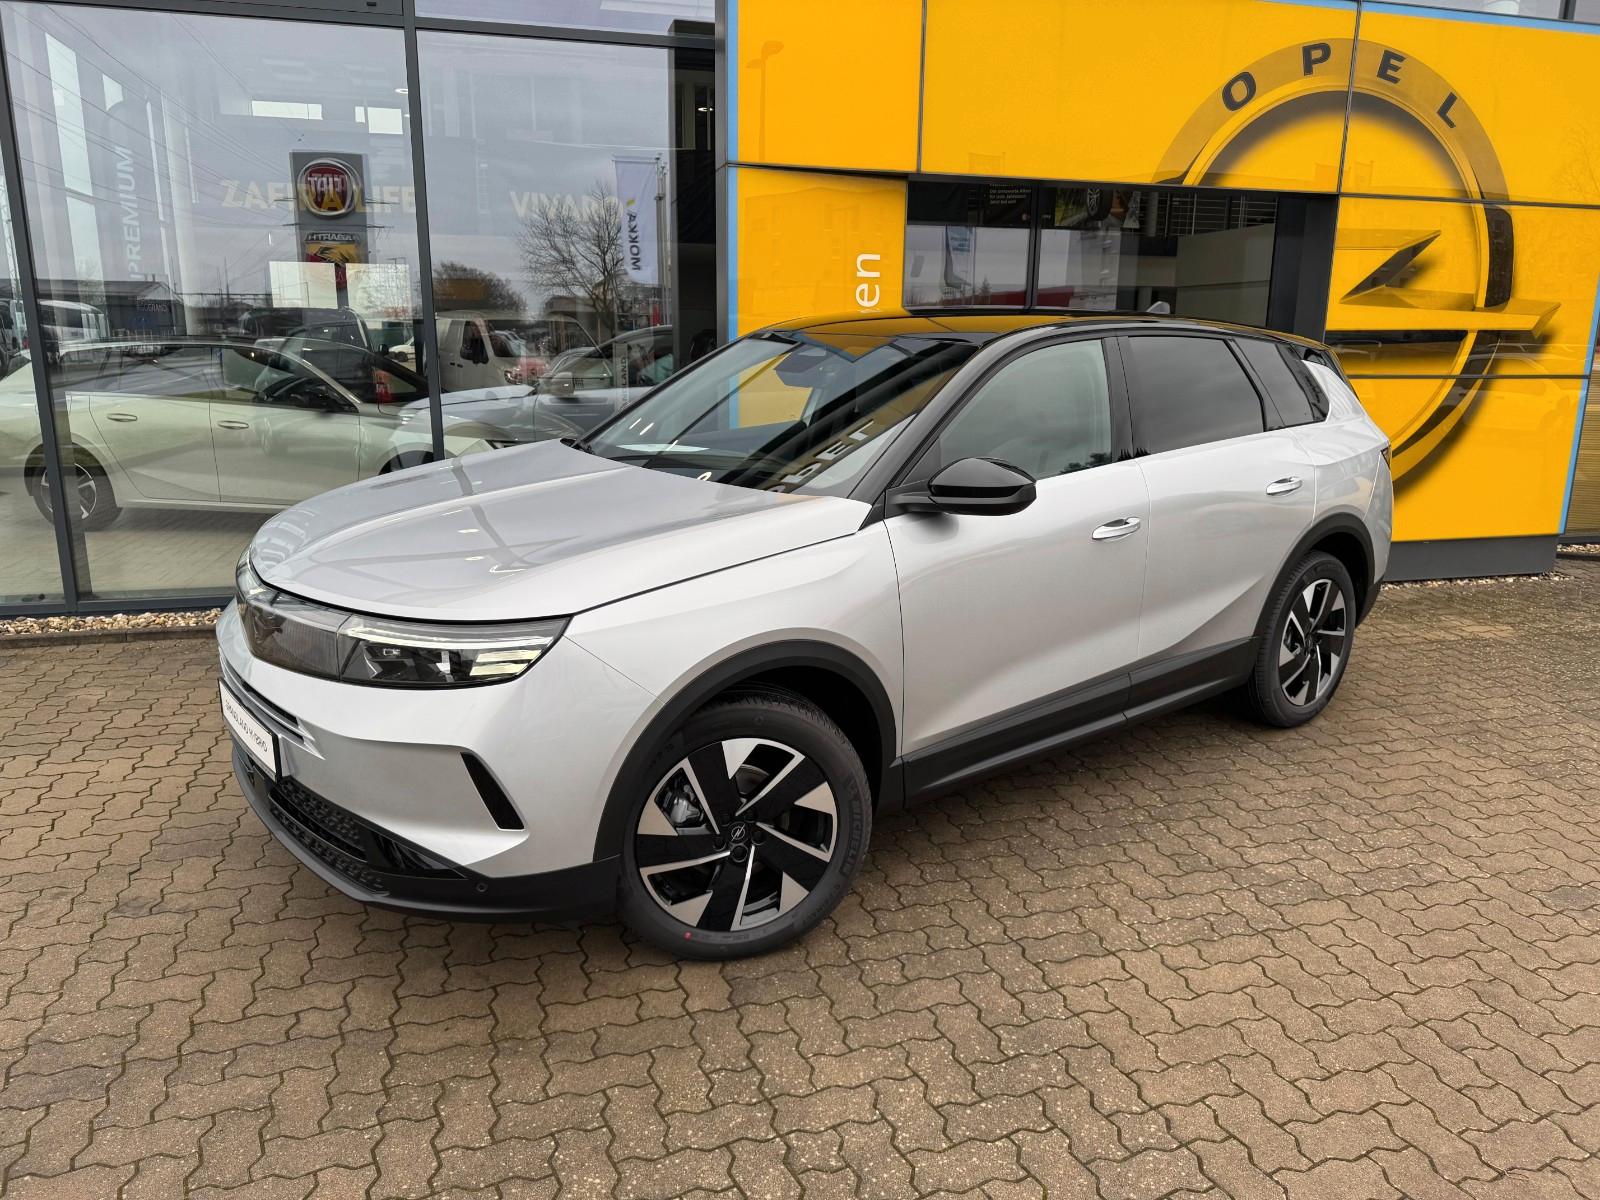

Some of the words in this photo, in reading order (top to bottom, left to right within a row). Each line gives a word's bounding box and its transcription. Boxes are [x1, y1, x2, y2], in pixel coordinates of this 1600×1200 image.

[1221, 42, 1458, 129] OPEL
[115, 145, 144, 279] PREMIUM
[855, 253, 881, 313] en
